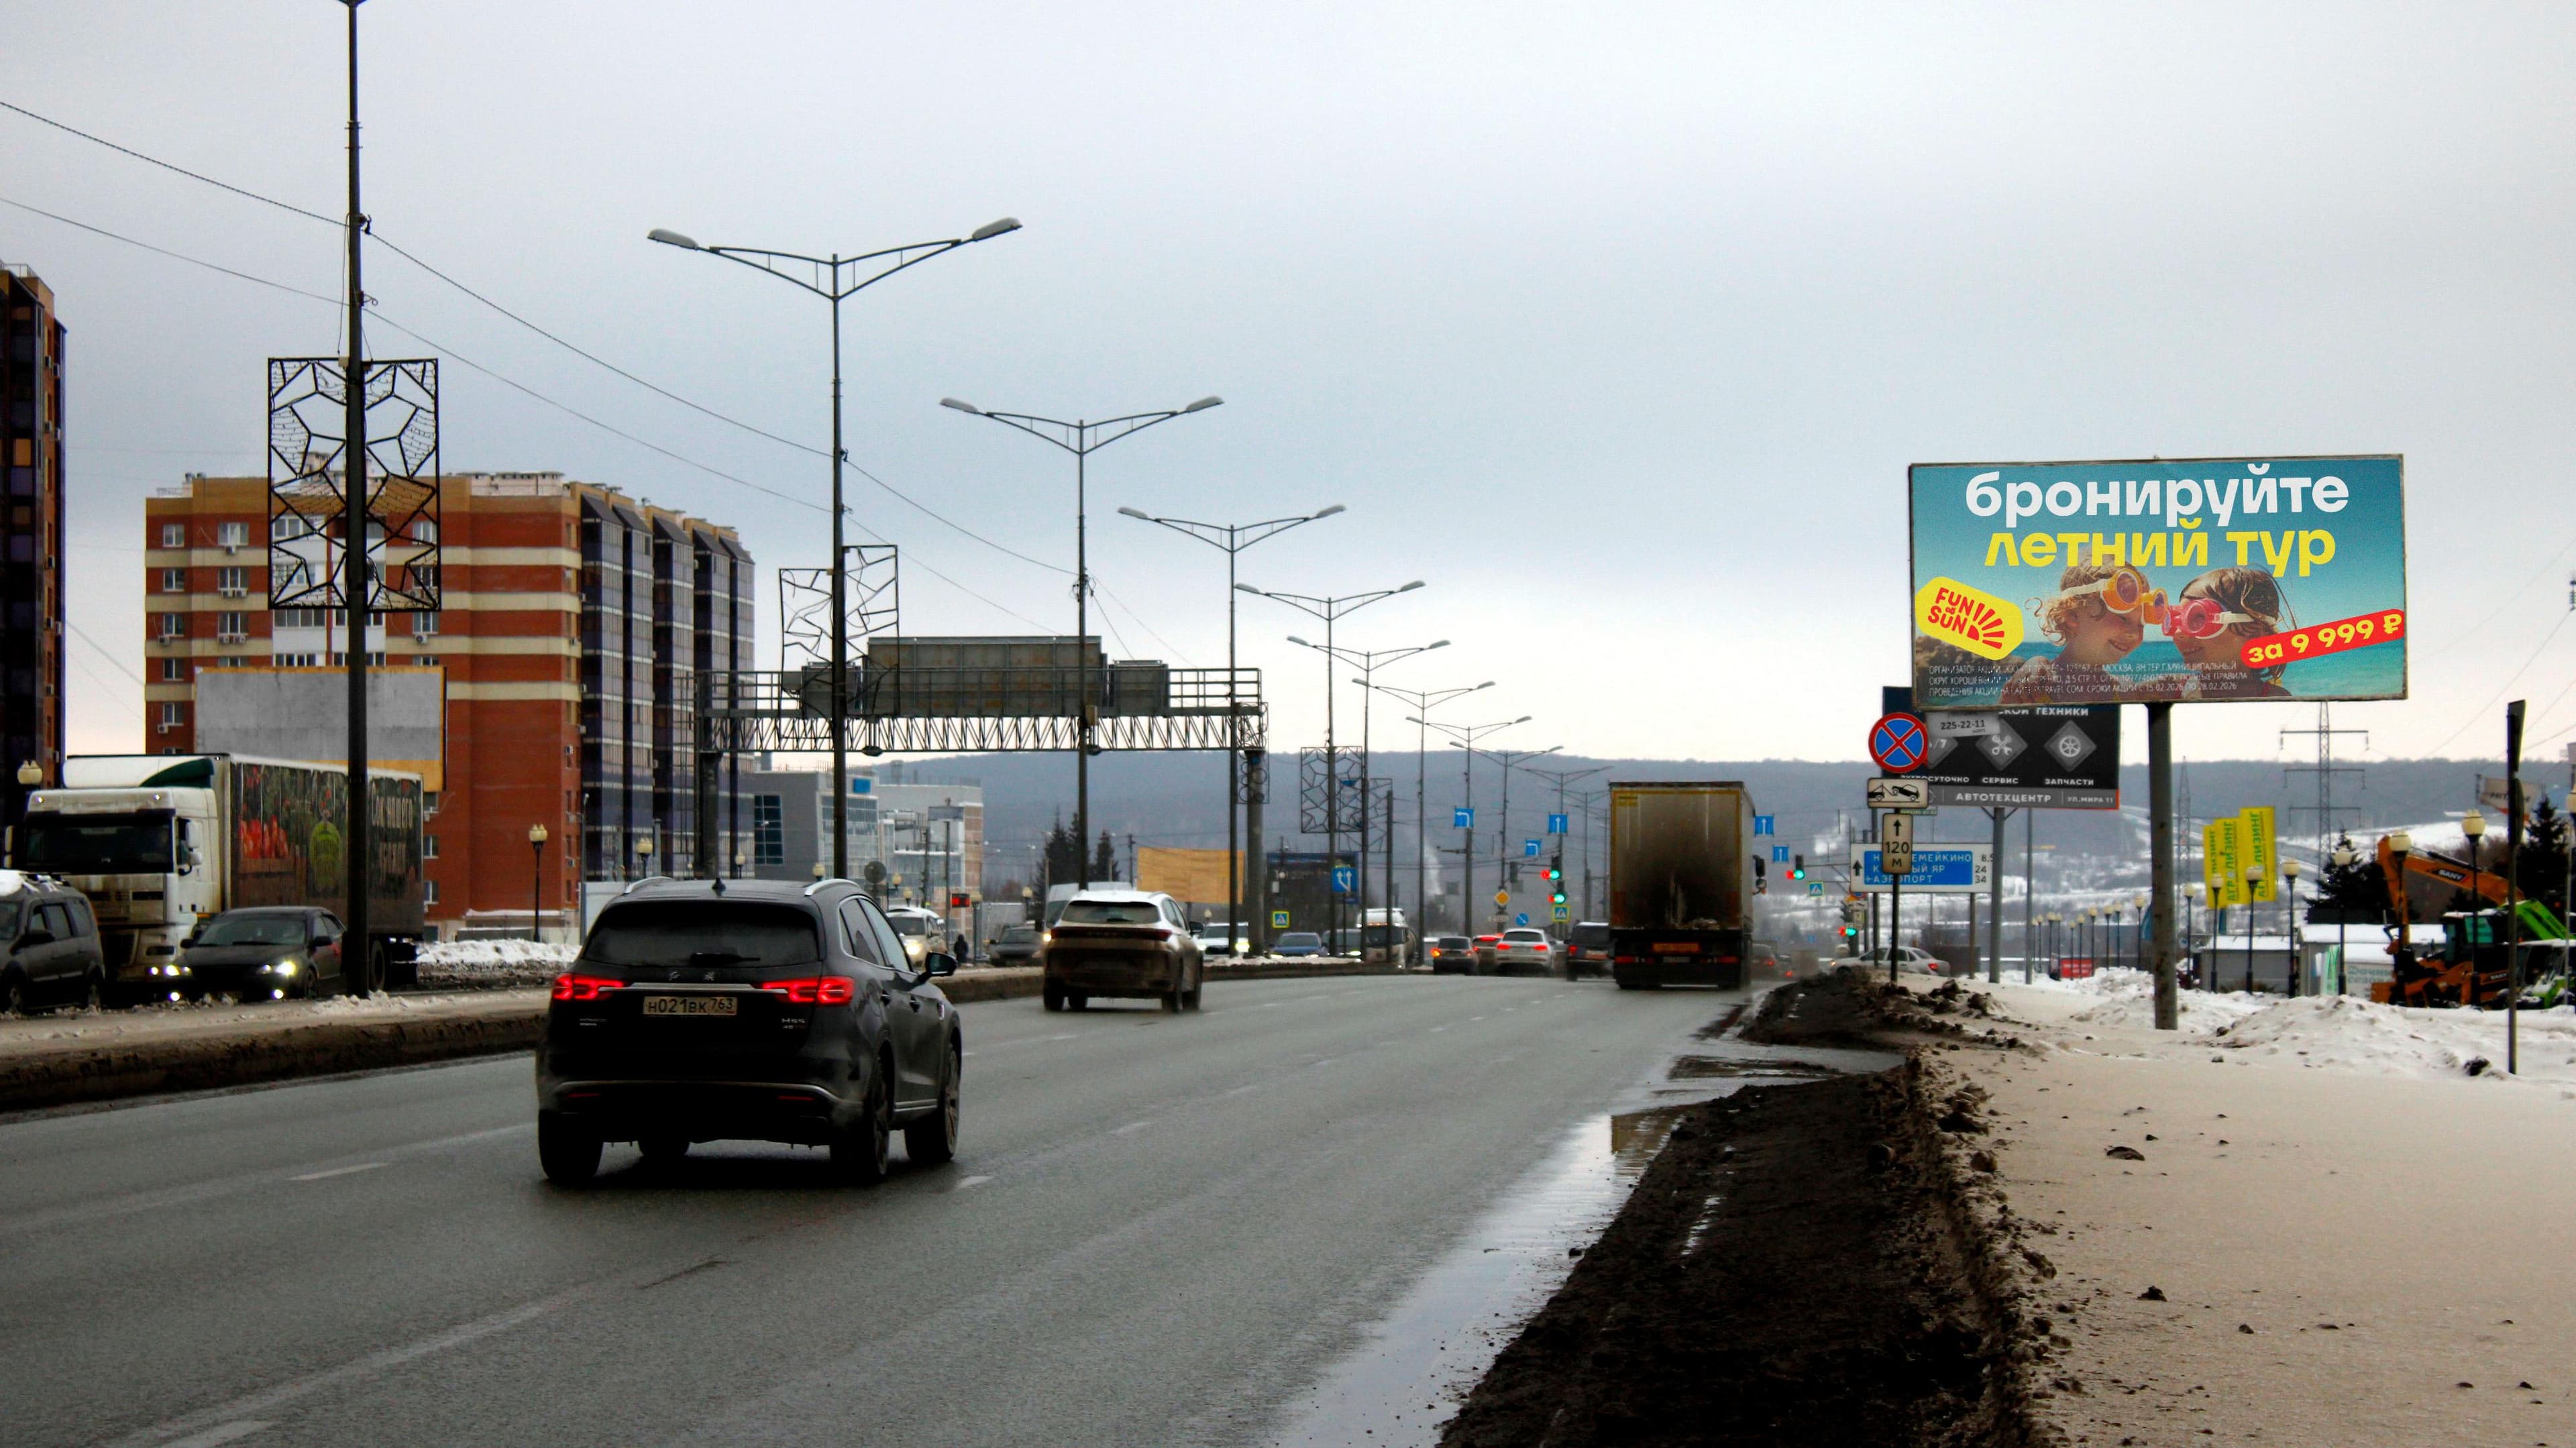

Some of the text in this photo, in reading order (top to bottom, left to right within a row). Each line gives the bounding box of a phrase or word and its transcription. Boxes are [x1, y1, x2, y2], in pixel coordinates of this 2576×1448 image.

[1966, 463, 2349, 528] бронируйте
[1984, 518, 2336, 577] летний тур
[1935, 587, 1974, 616] FUN
[1927, 606, 1968, 634] SUN
[2249, 643, 2284, 663] за
[2291, 634, 2310, 653] 9
[2318, 620, 2375, 648] 999
[2036, 708, 2088, 716] ТЕХНИКИ
[1941, 720, 1985, 730] 225-22-11
[1955, 792, 2051, 803] АВТОТЕХЦЕНТР
[1886, 841, 1909, 854] 120
[1932, 865, 1945, 873] ЯР
[2438, 869, 2463, 880] SANY
[1975, 876, 1987, 884] 34
[648, 998, 733, 1013] Н021ВК 763
